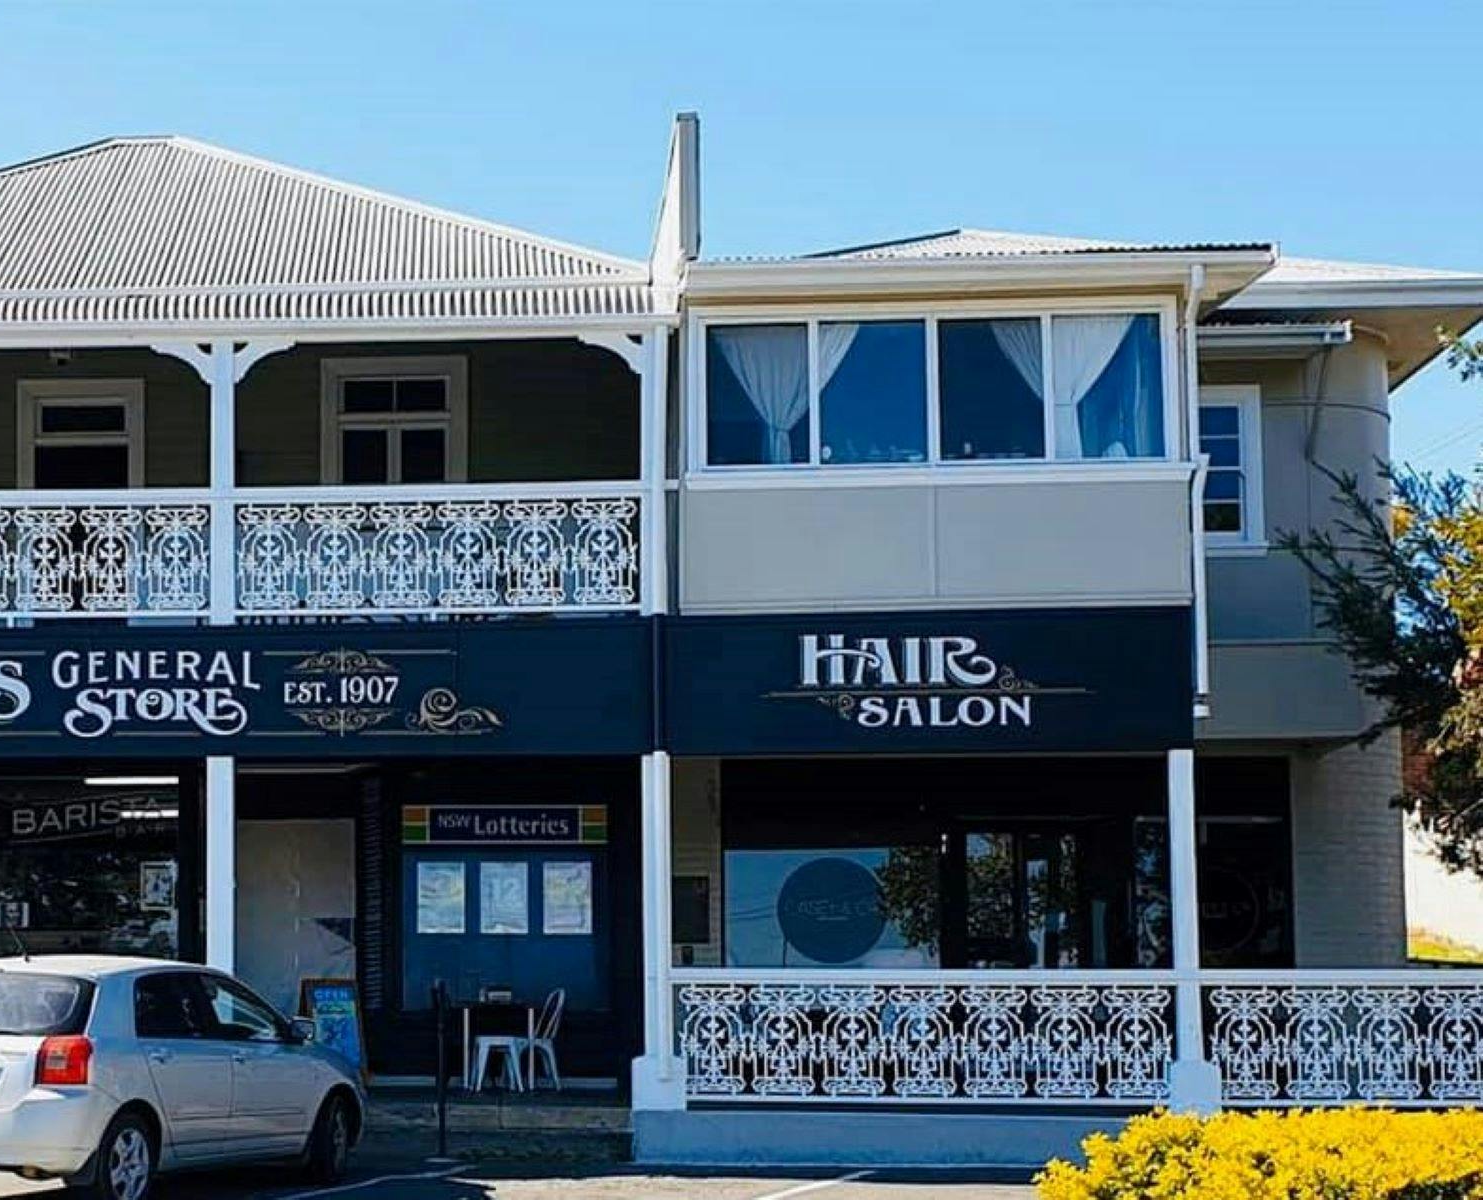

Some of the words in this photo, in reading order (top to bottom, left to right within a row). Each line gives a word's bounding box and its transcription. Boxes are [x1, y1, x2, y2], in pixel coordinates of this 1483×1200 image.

[52, 651, 261, 690] GENERAL
[798, 634, 996, 685] HAIR
[284, 681, 332, 703] EST.
[340, 676, 399, 703] 1907
[63, 688, 248, 737] STORE
[857, 696, 1031, 727] SALON
[12, 798, 158, 834] BARISTA
[438, 813, 471, 828] NSW
[474, 813, 569, 835] Lotteries
